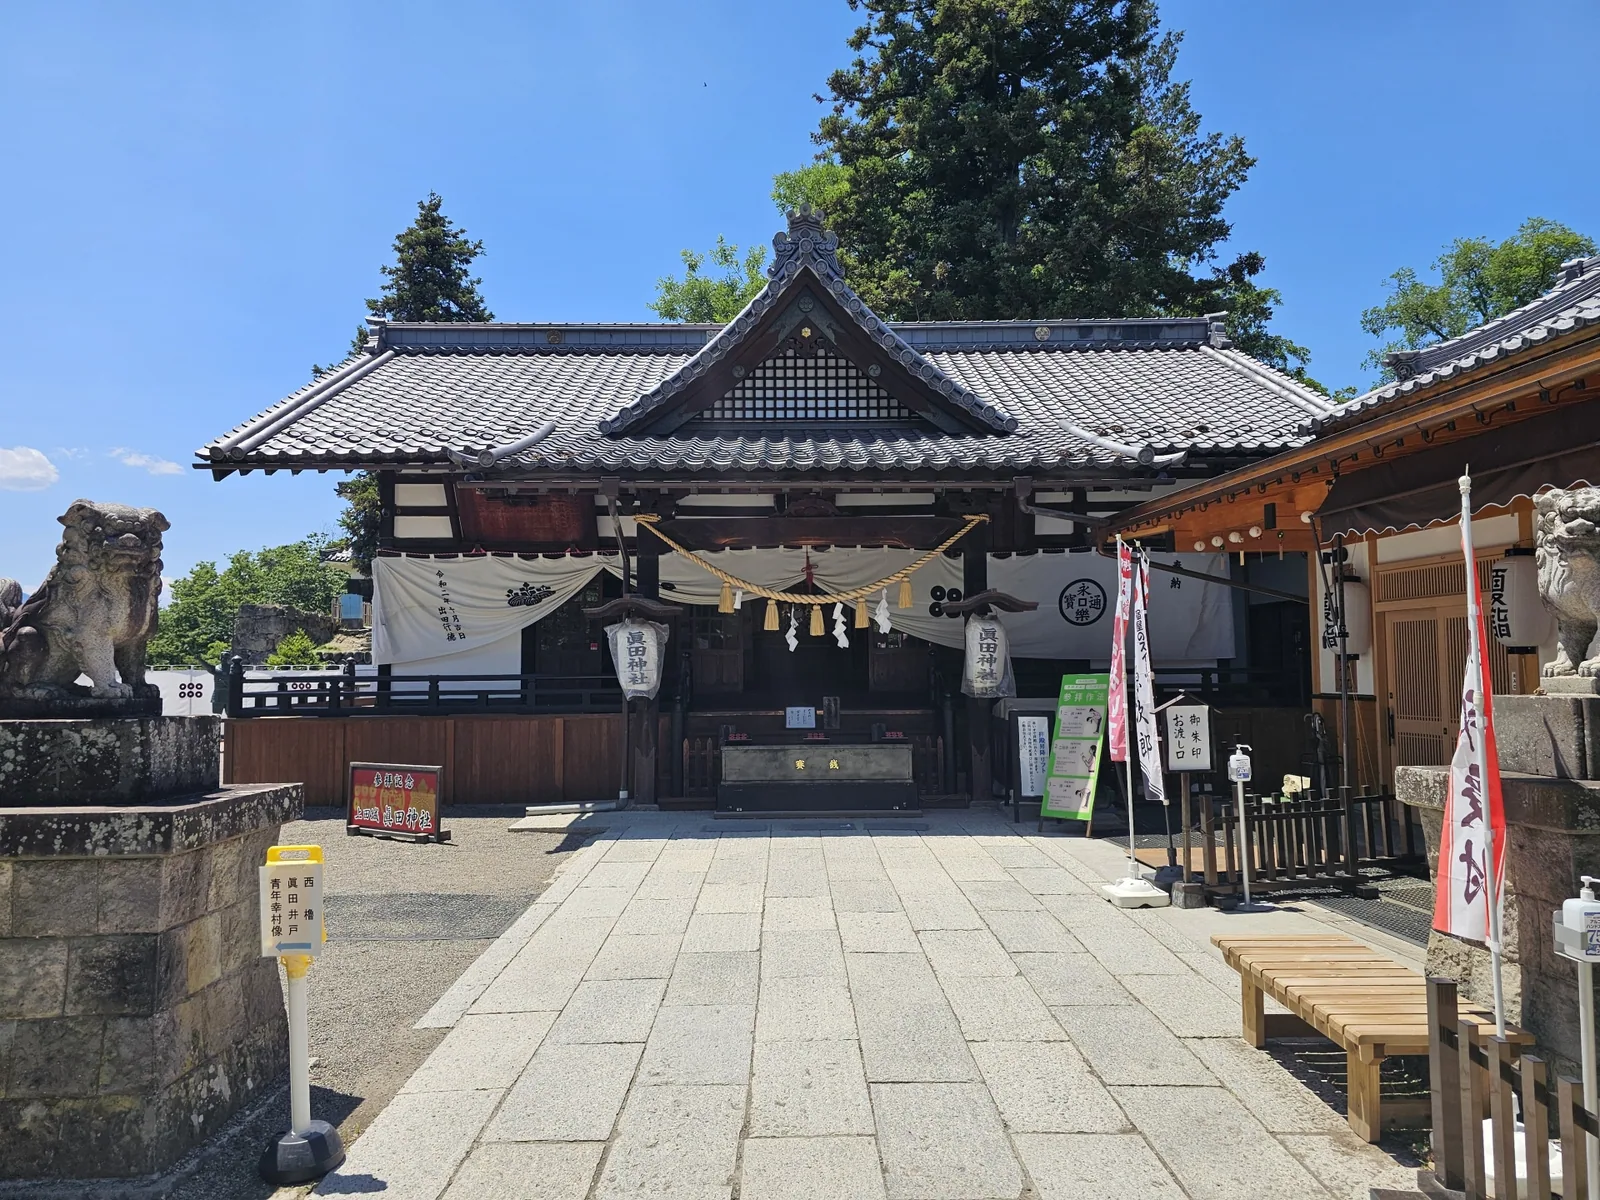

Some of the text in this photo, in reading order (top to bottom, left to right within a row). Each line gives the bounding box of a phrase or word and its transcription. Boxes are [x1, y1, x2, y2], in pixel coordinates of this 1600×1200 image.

[1172, 713, 1186, 760] お渡し口
[1189, 713, 1202, 760] 御朱印
[270, 877, 283, 937] 青年幸村像
[287, 876, 299, 936] 眞田井戸
